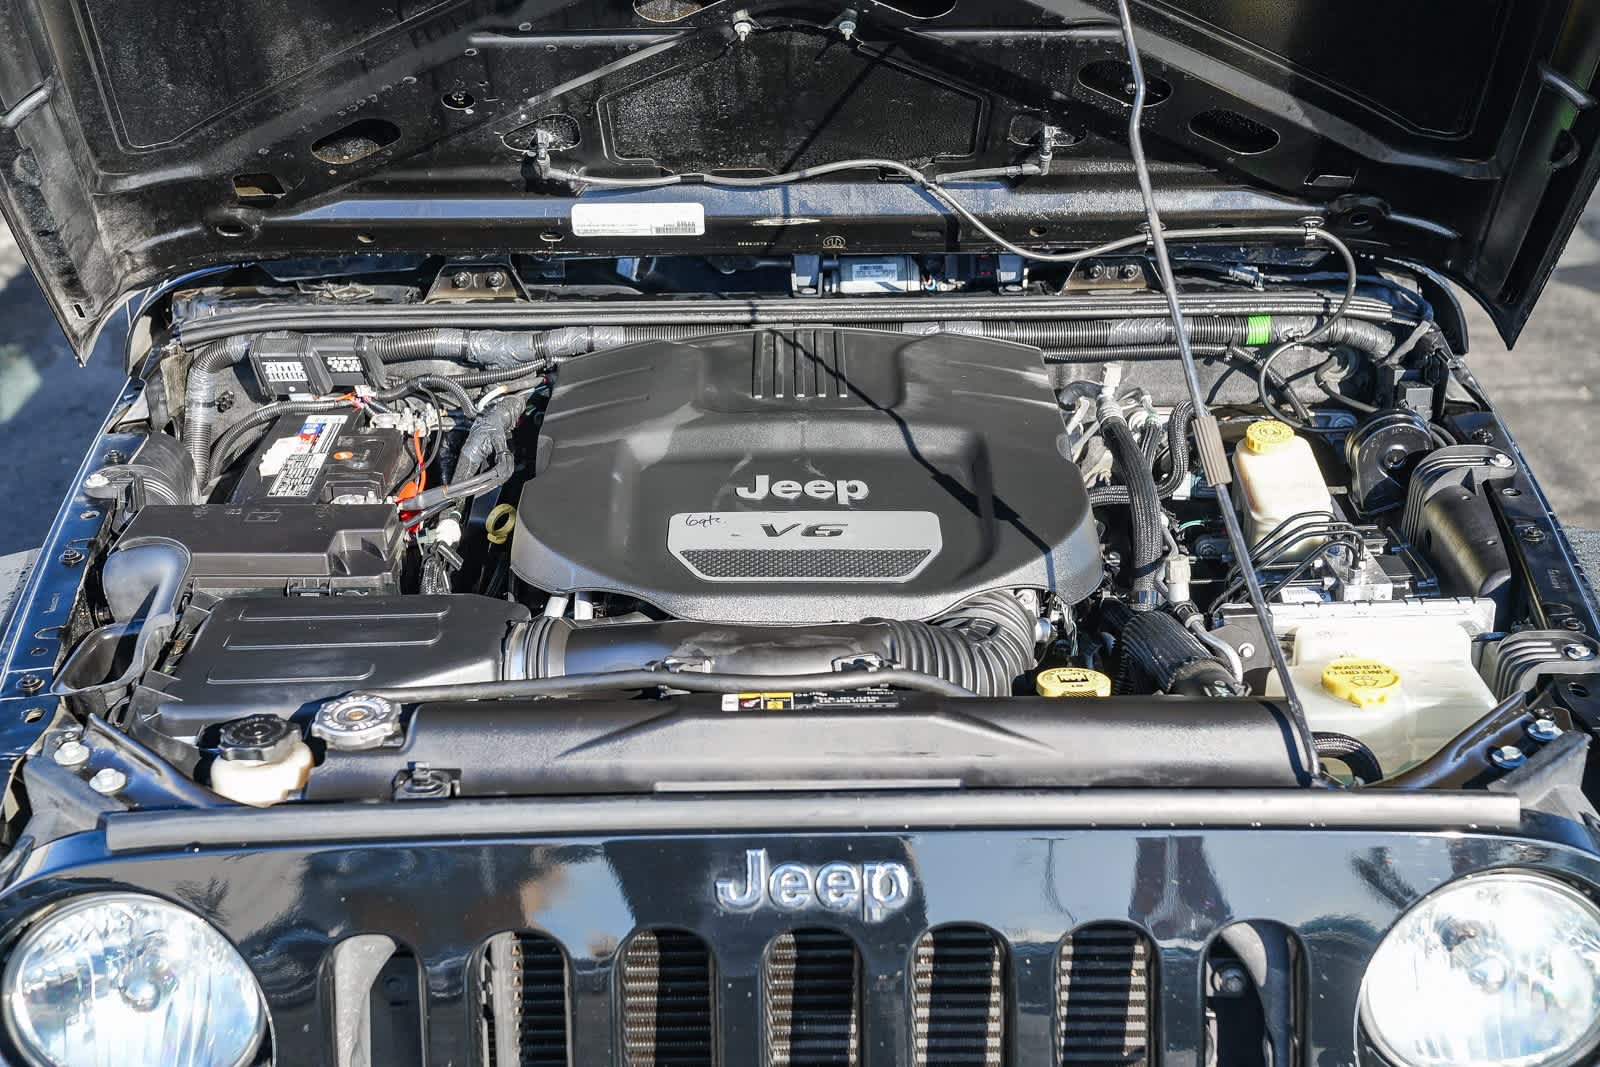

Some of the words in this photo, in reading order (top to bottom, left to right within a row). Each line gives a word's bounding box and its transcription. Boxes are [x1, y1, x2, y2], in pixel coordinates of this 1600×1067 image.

[735, 474, 869, 505] Jeep
[760, 523, 848, 538] V6
[714, 848, 911, 923] Jeep
